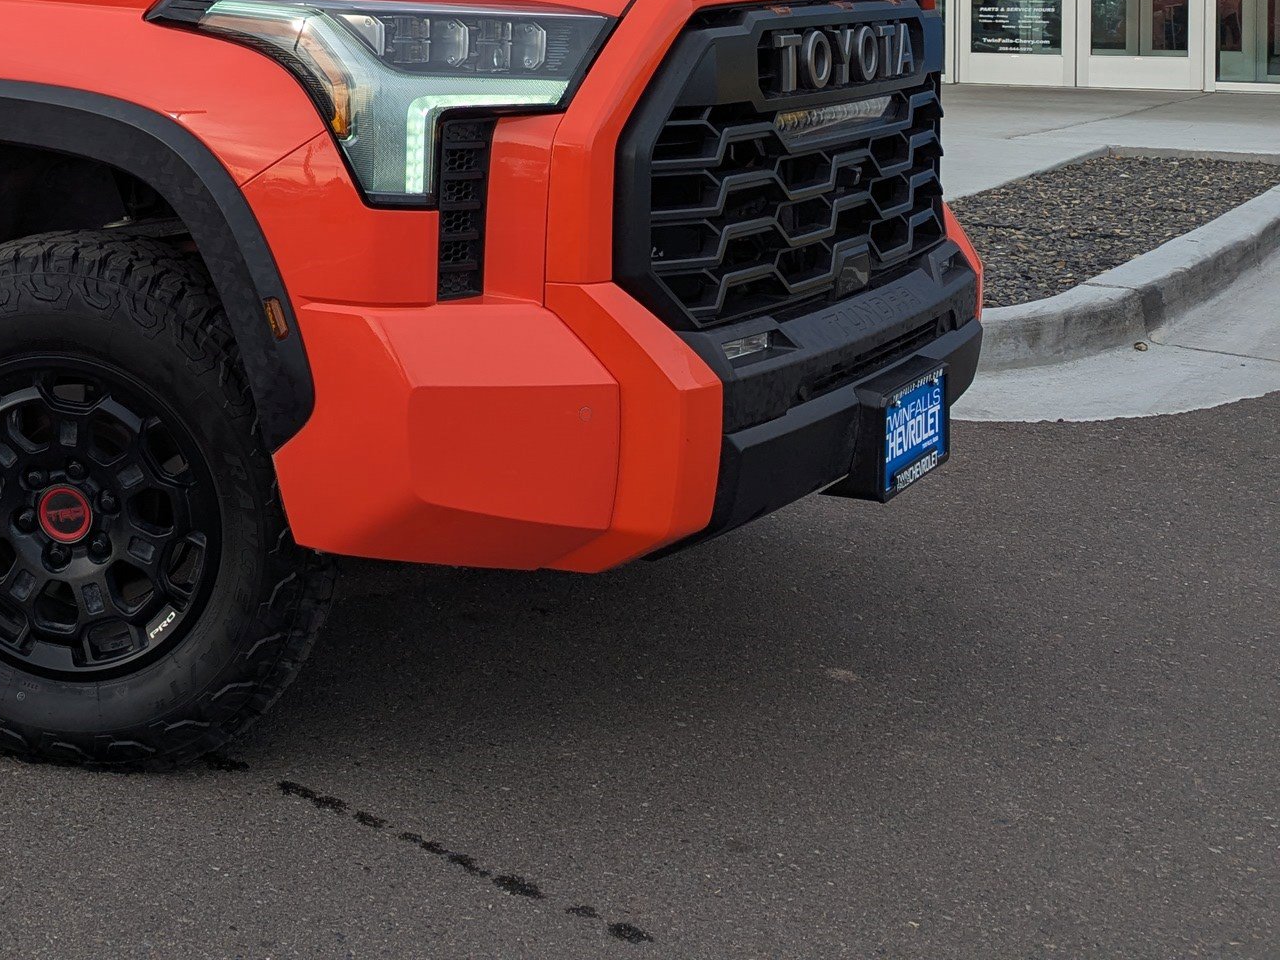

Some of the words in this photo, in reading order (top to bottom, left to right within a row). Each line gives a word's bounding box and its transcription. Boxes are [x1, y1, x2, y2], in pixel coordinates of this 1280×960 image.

[982, 37, 1051, 45] TwinFalls-Chevy.com
[773, 23, 915, 92] TOYOTA
[909, 449, 938, 483] CHEVROLET
[149, 611, 176, 639] PRO
